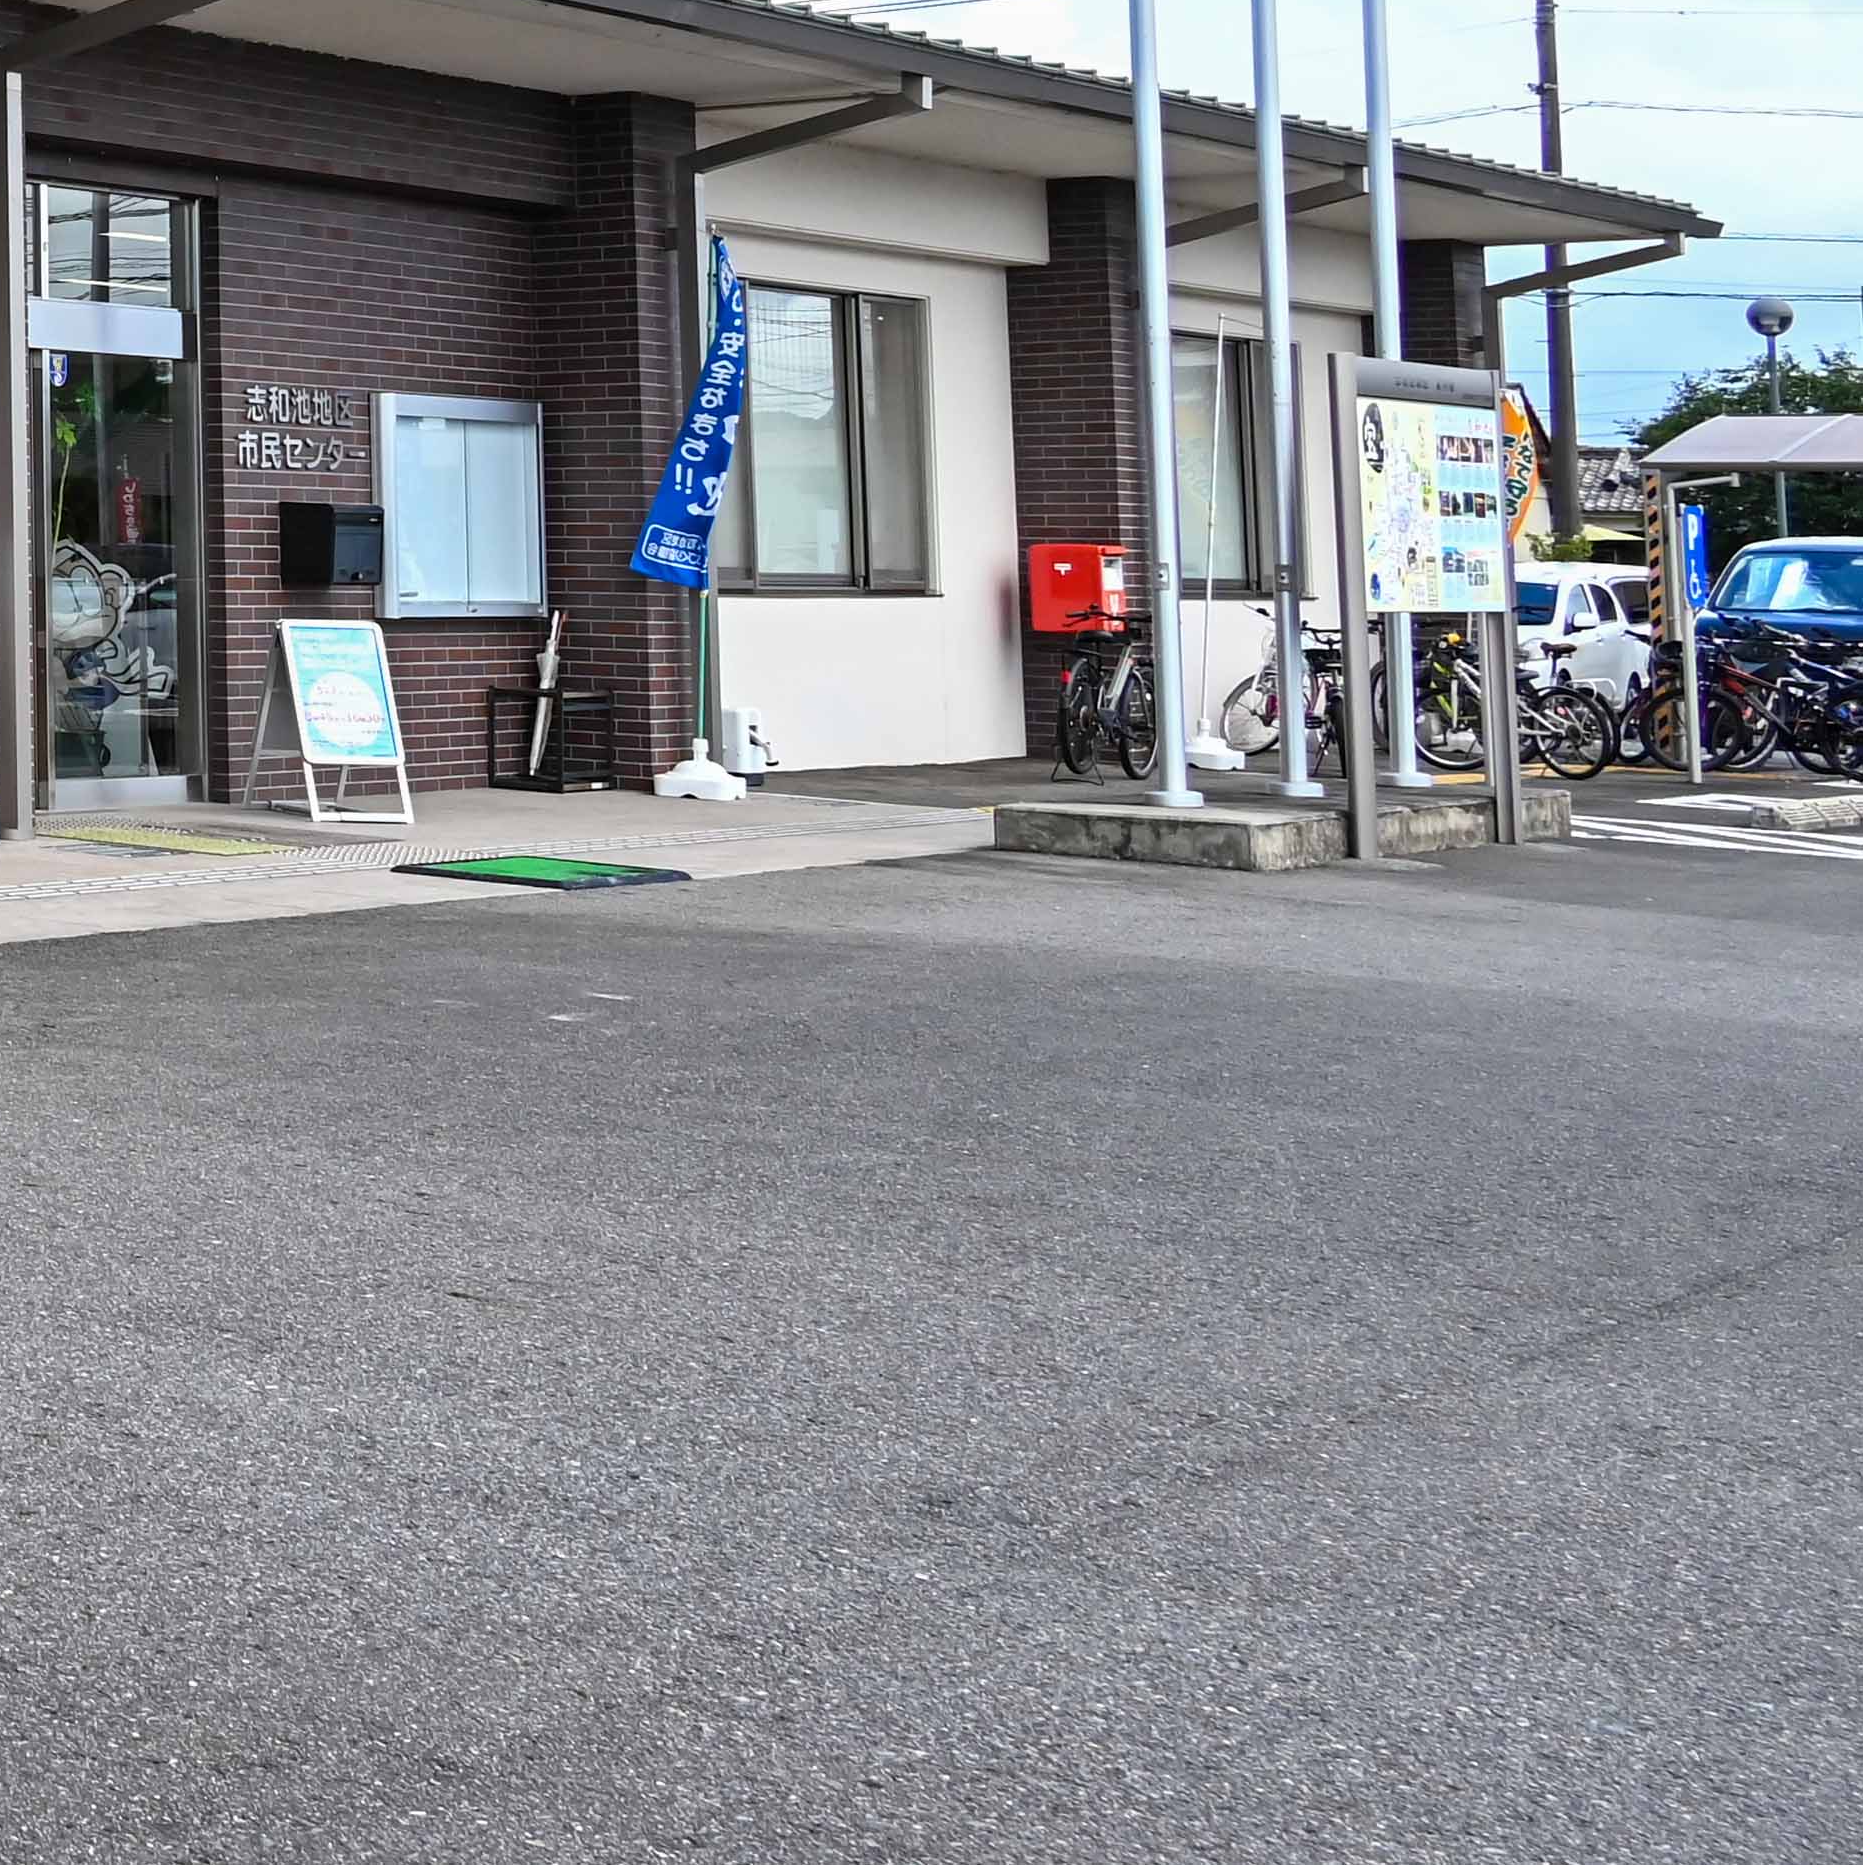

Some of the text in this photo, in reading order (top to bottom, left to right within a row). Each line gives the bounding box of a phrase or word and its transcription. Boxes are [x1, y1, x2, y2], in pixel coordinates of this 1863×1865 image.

[246, 385, 353, 426] 志和池地区
[238, 430, 366, 470] 市民センター
[1687, 514, 1698, 550] P
